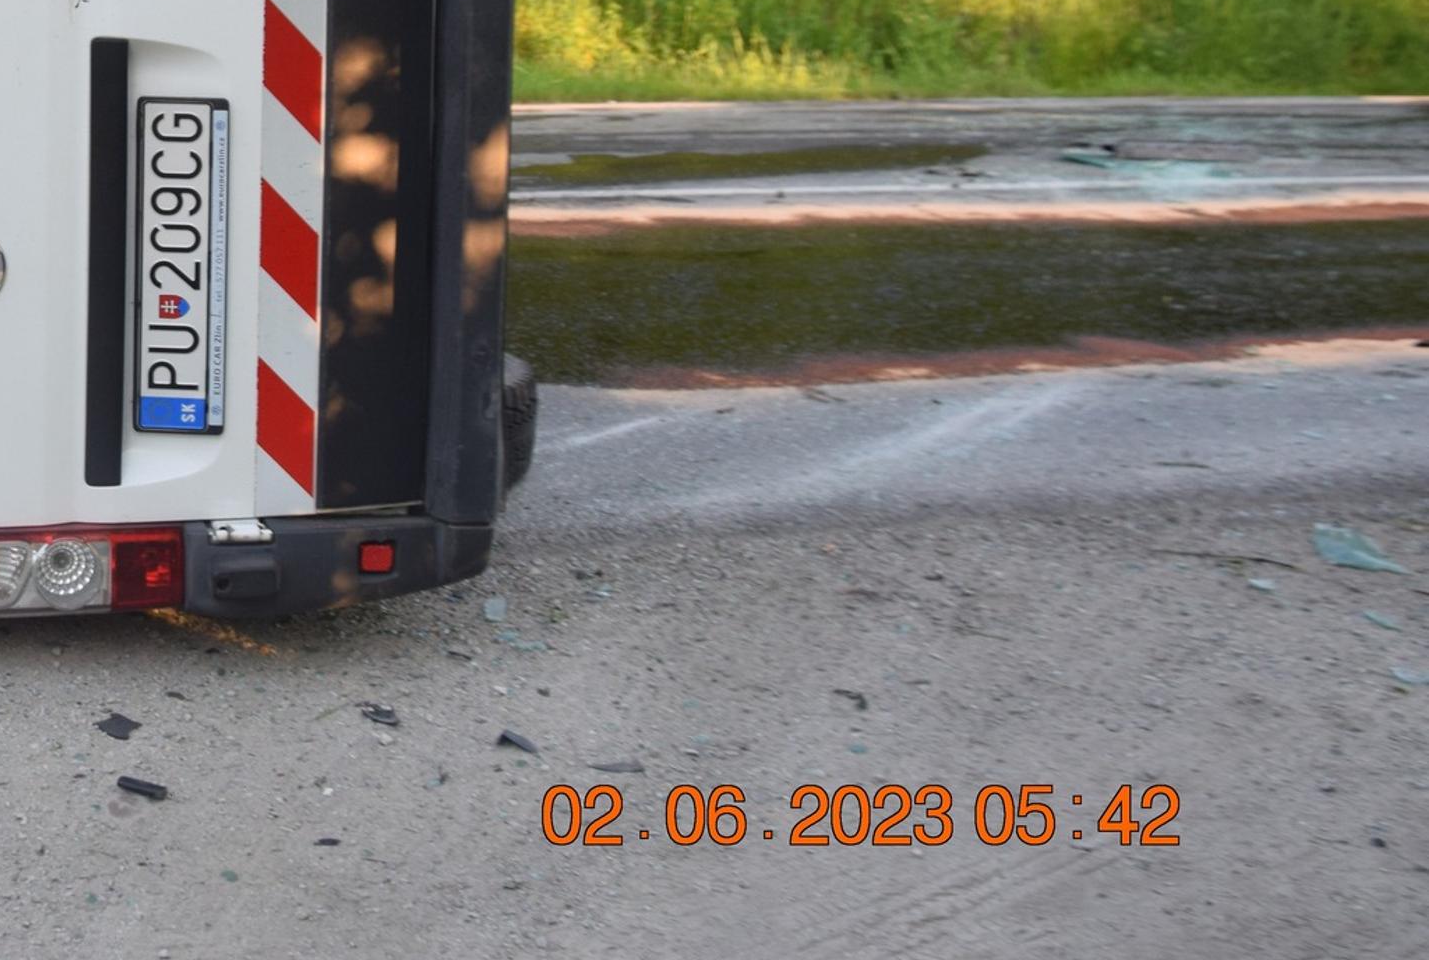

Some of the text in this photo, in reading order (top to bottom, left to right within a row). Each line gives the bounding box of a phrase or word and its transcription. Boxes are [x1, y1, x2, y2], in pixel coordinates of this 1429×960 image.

[148, 112, 203, 390] PU 209CG
[181, 403, 196, 423] SK
